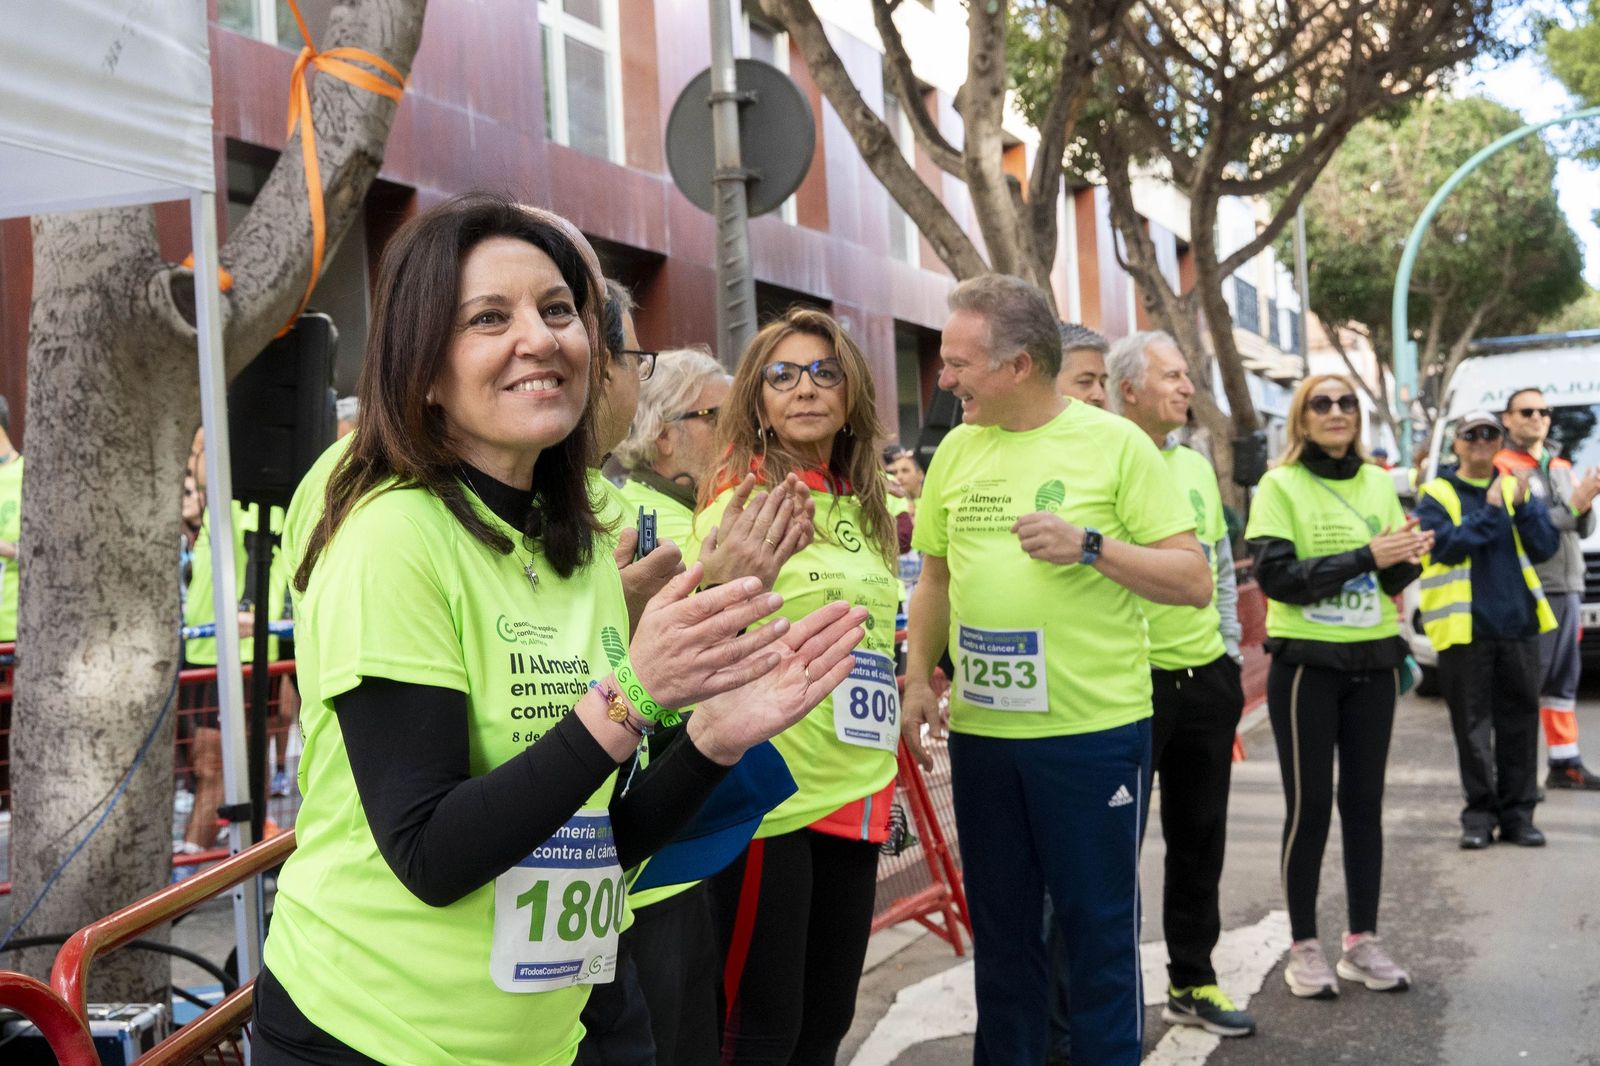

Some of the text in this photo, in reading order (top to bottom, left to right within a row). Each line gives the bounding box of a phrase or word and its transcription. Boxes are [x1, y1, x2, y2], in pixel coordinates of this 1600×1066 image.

[969, 493, 1012, 504] Almería
[969, 505, 1004, 513] marcha
[984, 514, 993, 522] el
[987, 643, 1015, 653] cáncer
[510, 653, 525, 674] II
[961, 655, 1037, 689] 1253
[510, 678, 588, 696] en marcha
[510, 701, 570, 719] contra
[849, 686, 897, 726] 809
[512, 731, 540, 742] 8 de
[552, 823, 596, 839] mería
[532, 844, 582, 860] contra
[585, 844, 596, 860] el
[516, 874, 625, 942] 1800
